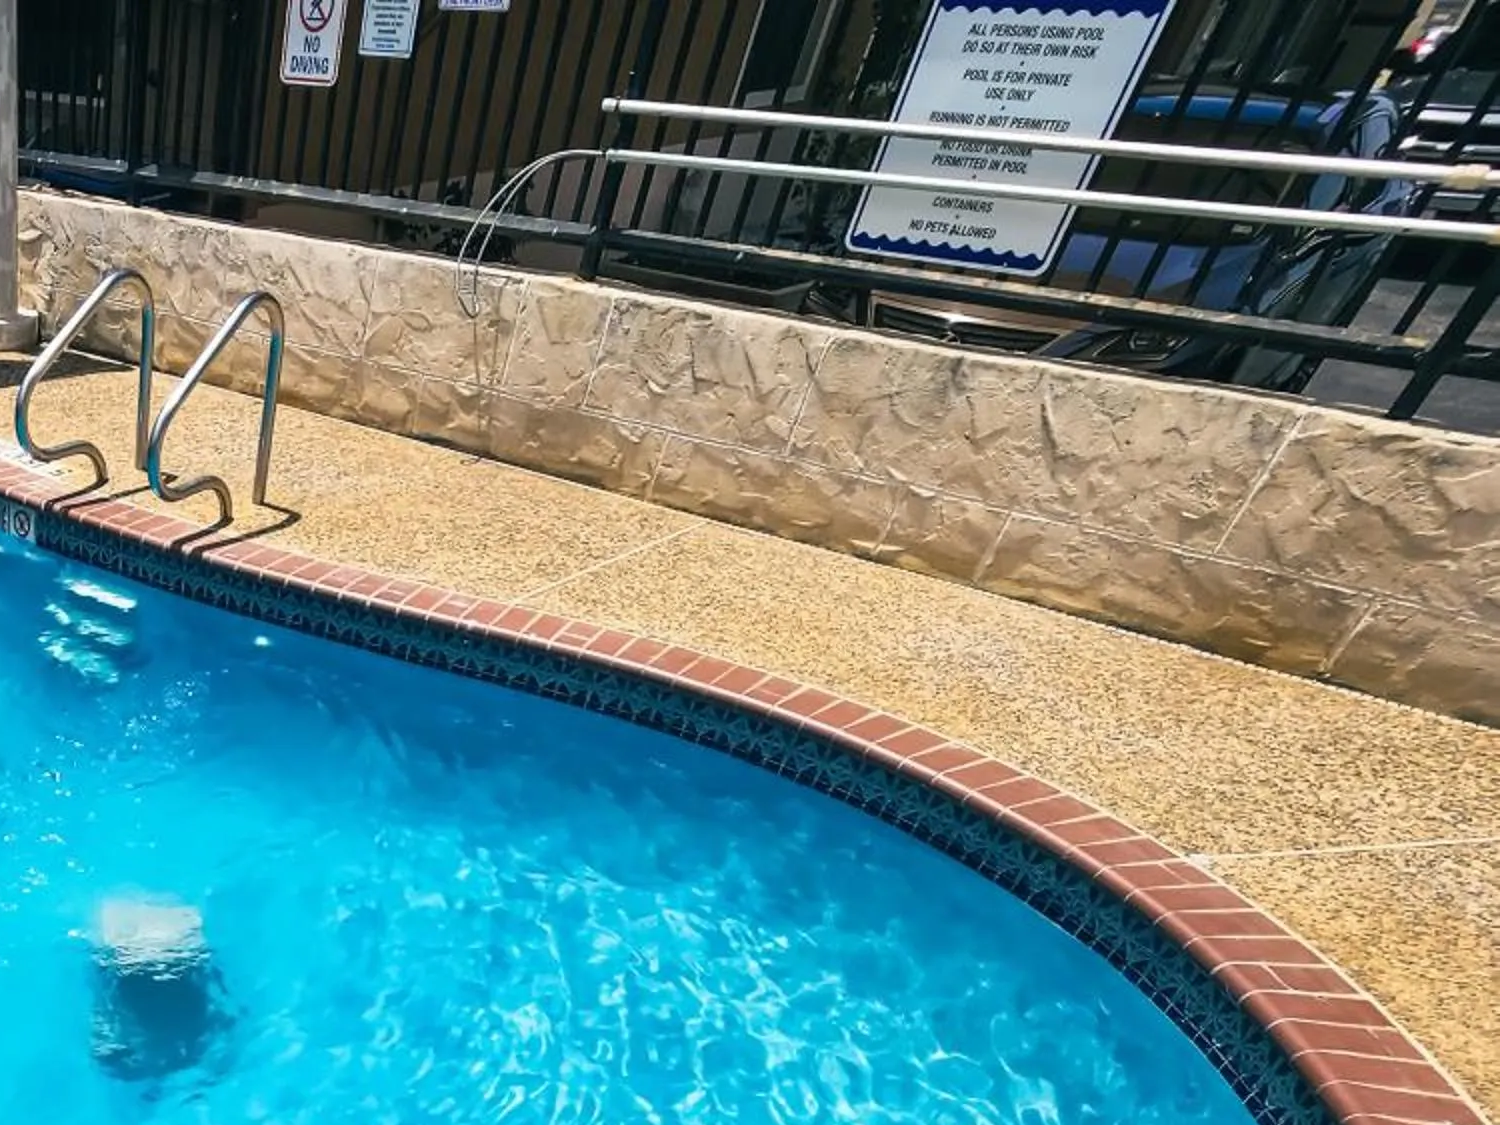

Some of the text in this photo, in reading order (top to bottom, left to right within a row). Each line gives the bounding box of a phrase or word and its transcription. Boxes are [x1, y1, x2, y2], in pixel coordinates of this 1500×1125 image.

[968, 23, 1105, 41] ALL PERSONS USING POOL
[303, 34, 321, 53] NO
[961, 40, 1100, 59] DO SO AT THEIR OWN RISK
[290, 55, 329, 75] DIVING
[962, 68, 1073, 87] POOL IS FOR PRIVATE
[984, 87, 1036, 101] USE ONLY
[929, 111, 1071, 133] RUNNING IS NOT PERMITTED
[932, 154, 1028, 174] PERMITTED IN POOL
[932, 196, 995, 214] CONTAINERS
[908, 219, 997, 239] NO PETS ALLOWED
